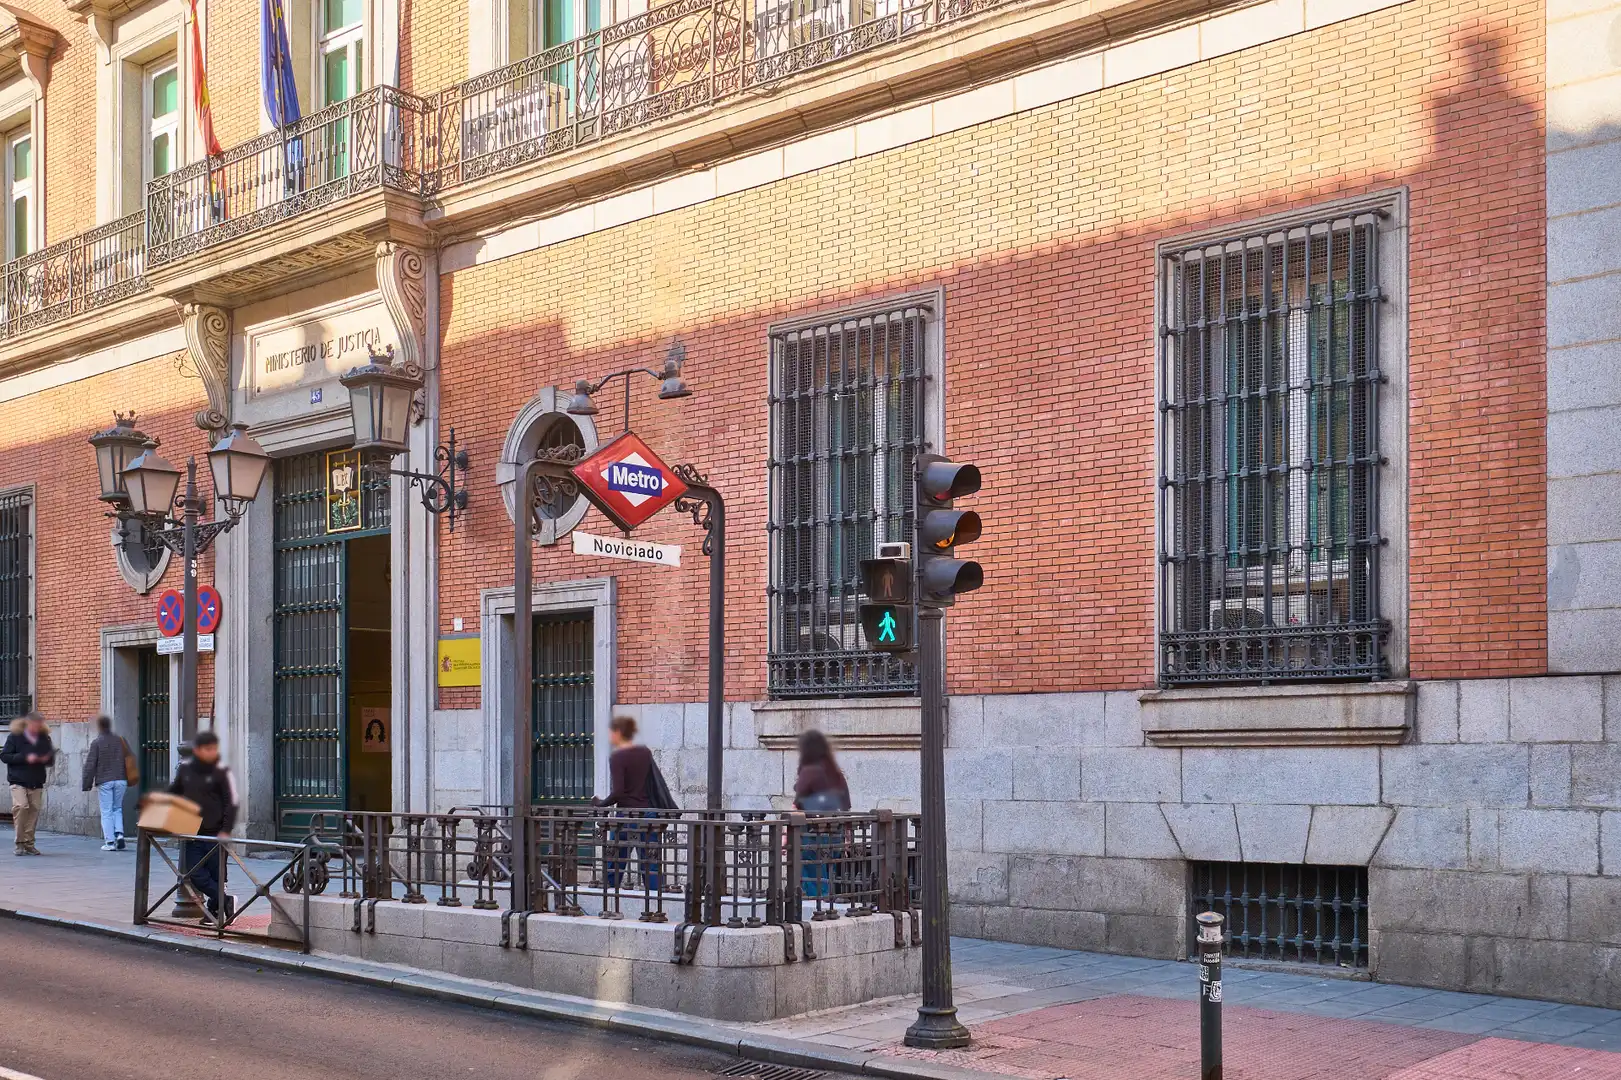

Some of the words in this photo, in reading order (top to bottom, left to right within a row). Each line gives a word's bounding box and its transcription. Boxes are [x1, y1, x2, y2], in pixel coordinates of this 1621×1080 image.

[265, 343, 317, 373] MINISTERIO
[320, 339, 334, 359] DE
[337, 327, 381, 359] JUSTICIA
[336, 473, 349, 487] LEX
[612, 465, 660, 490] Metro
[593, 539, 663, 560] Noviciado
